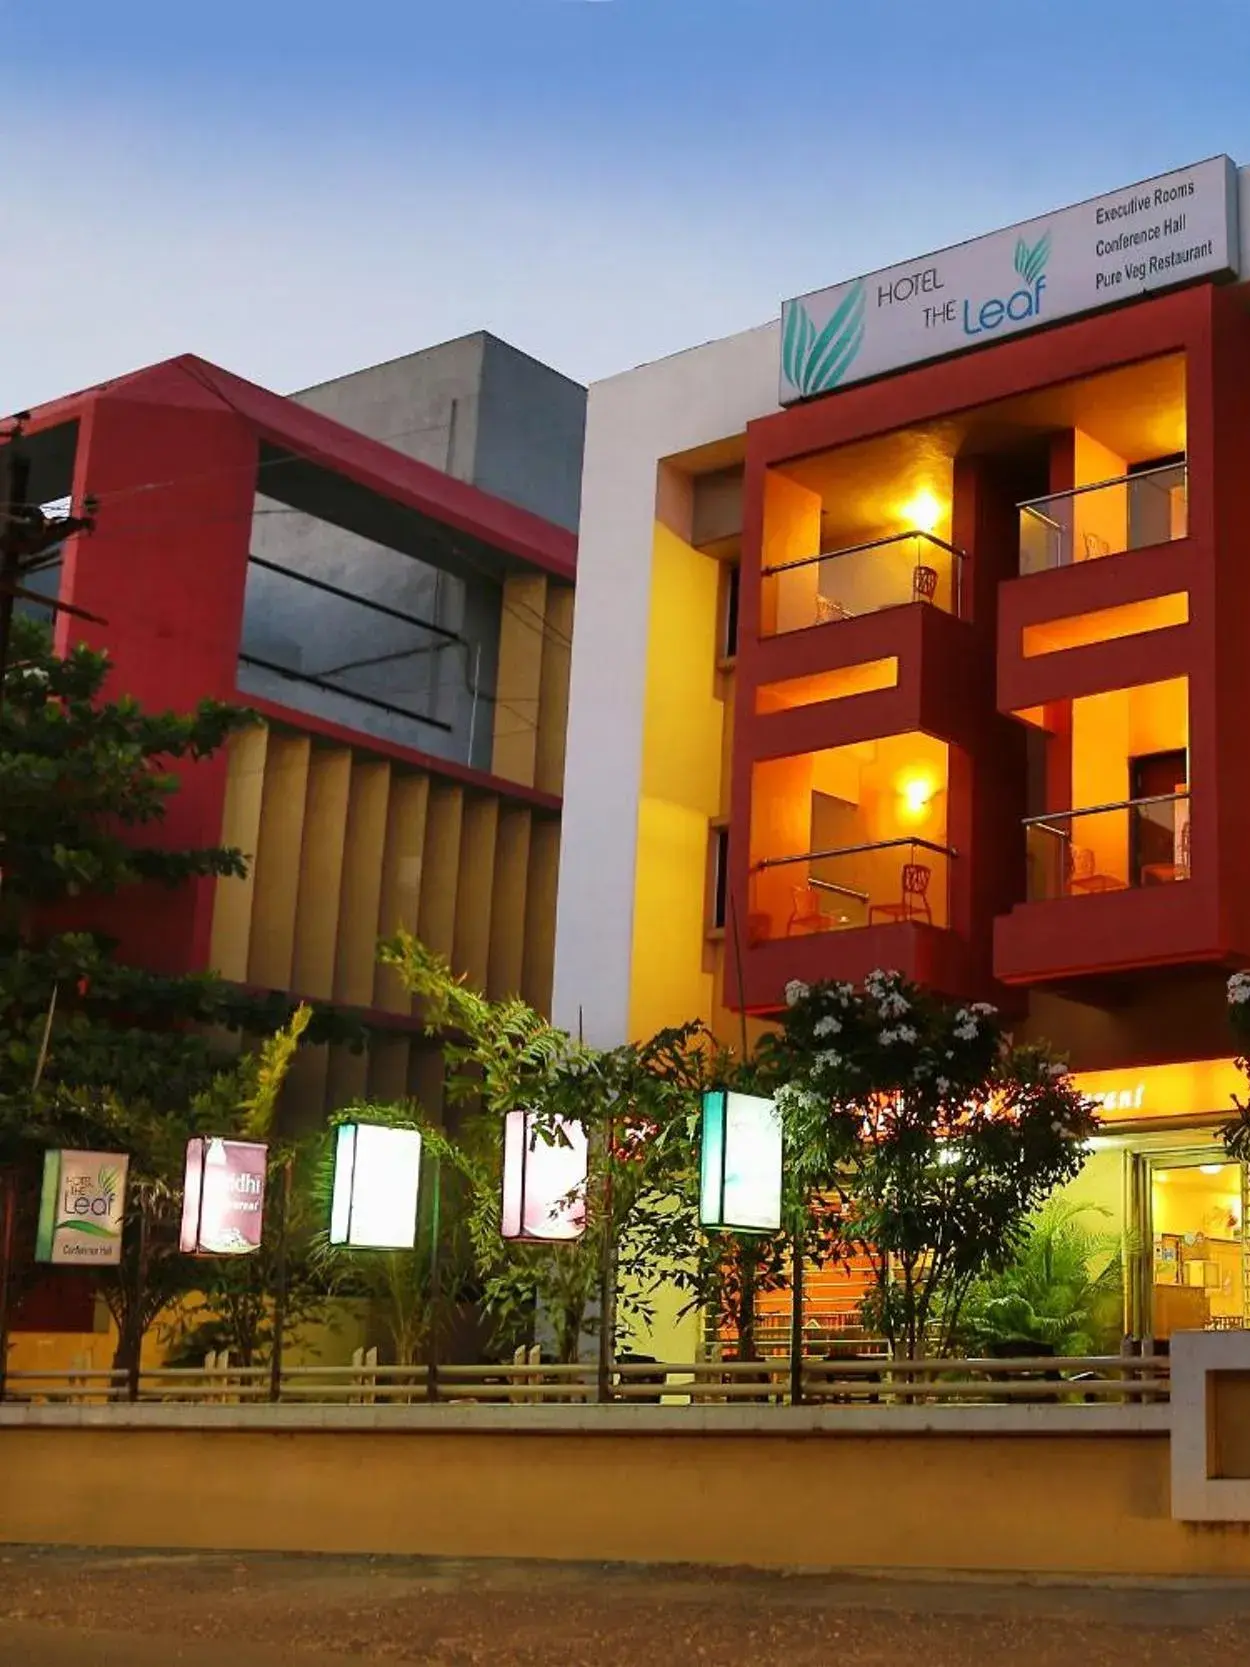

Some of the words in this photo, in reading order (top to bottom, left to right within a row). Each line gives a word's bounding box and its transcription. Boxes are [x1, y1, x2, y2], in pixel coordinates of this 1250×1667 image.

[1096, 196, 1151, 225] Executive
[1154, 182, 1195, 206] Rooms
[1096, 226, 1161, 257] Conference
[1164, 213, 1186, 236] Hall
[1096, 271, 1123, 290] Pure
[1125, 262, 1146, 281] Veg
[1149, 240, 1213, 273] Restaurant
[878, 268, 944, 307] HOTEL
[923, 300, 957, 328] THE
[964, 275, 1047, 335] Leaf
[64, 1190, 115, 1216] Leaf
